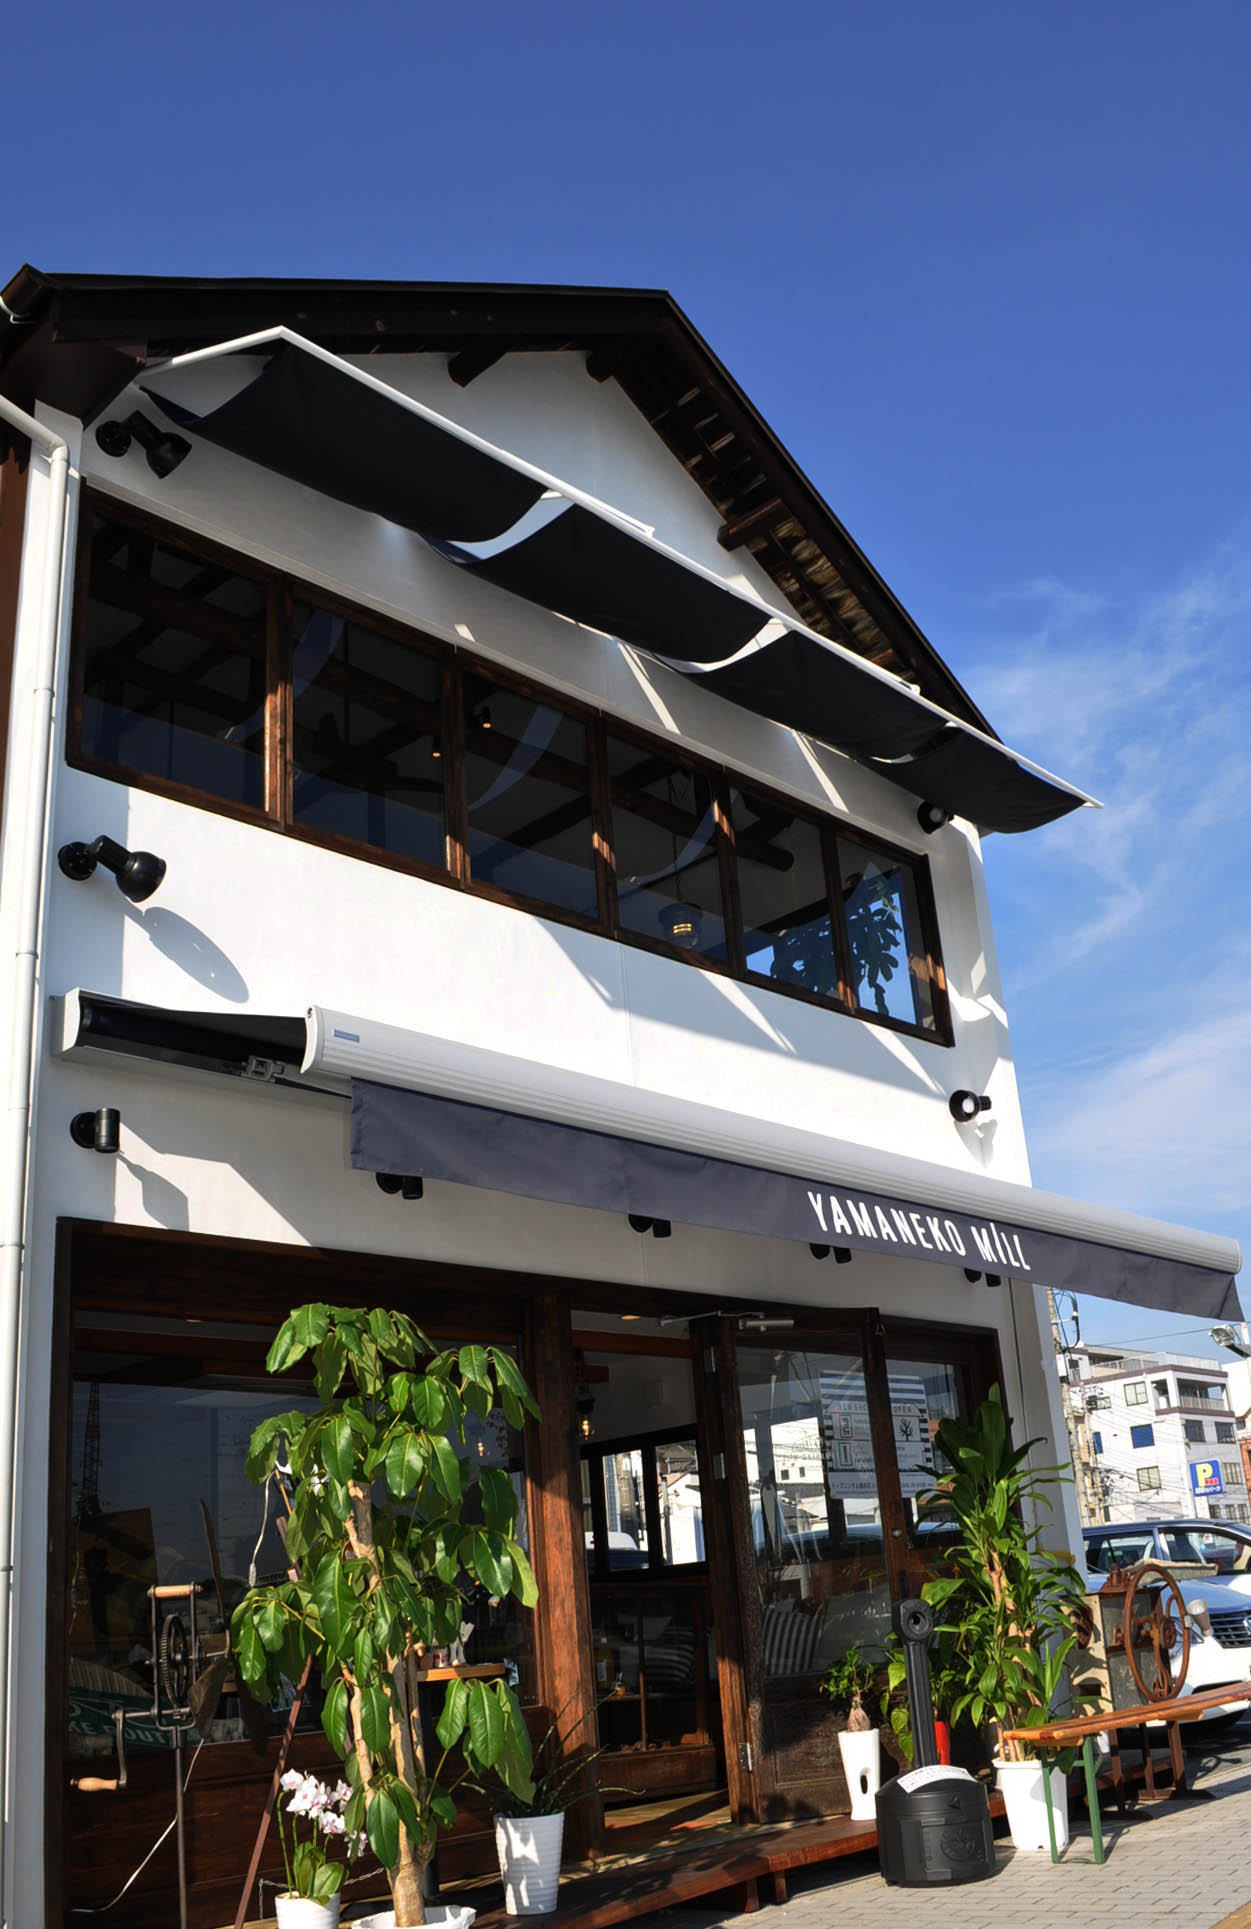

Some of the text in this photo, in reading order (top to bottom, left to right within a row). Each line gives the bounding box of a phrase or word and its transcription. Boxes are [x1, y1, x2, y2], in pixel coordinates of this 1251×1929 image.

[808, 1191, 1031, 1271] YAMANEKO MILL
[1196, 1463, 1213, 1487] P
